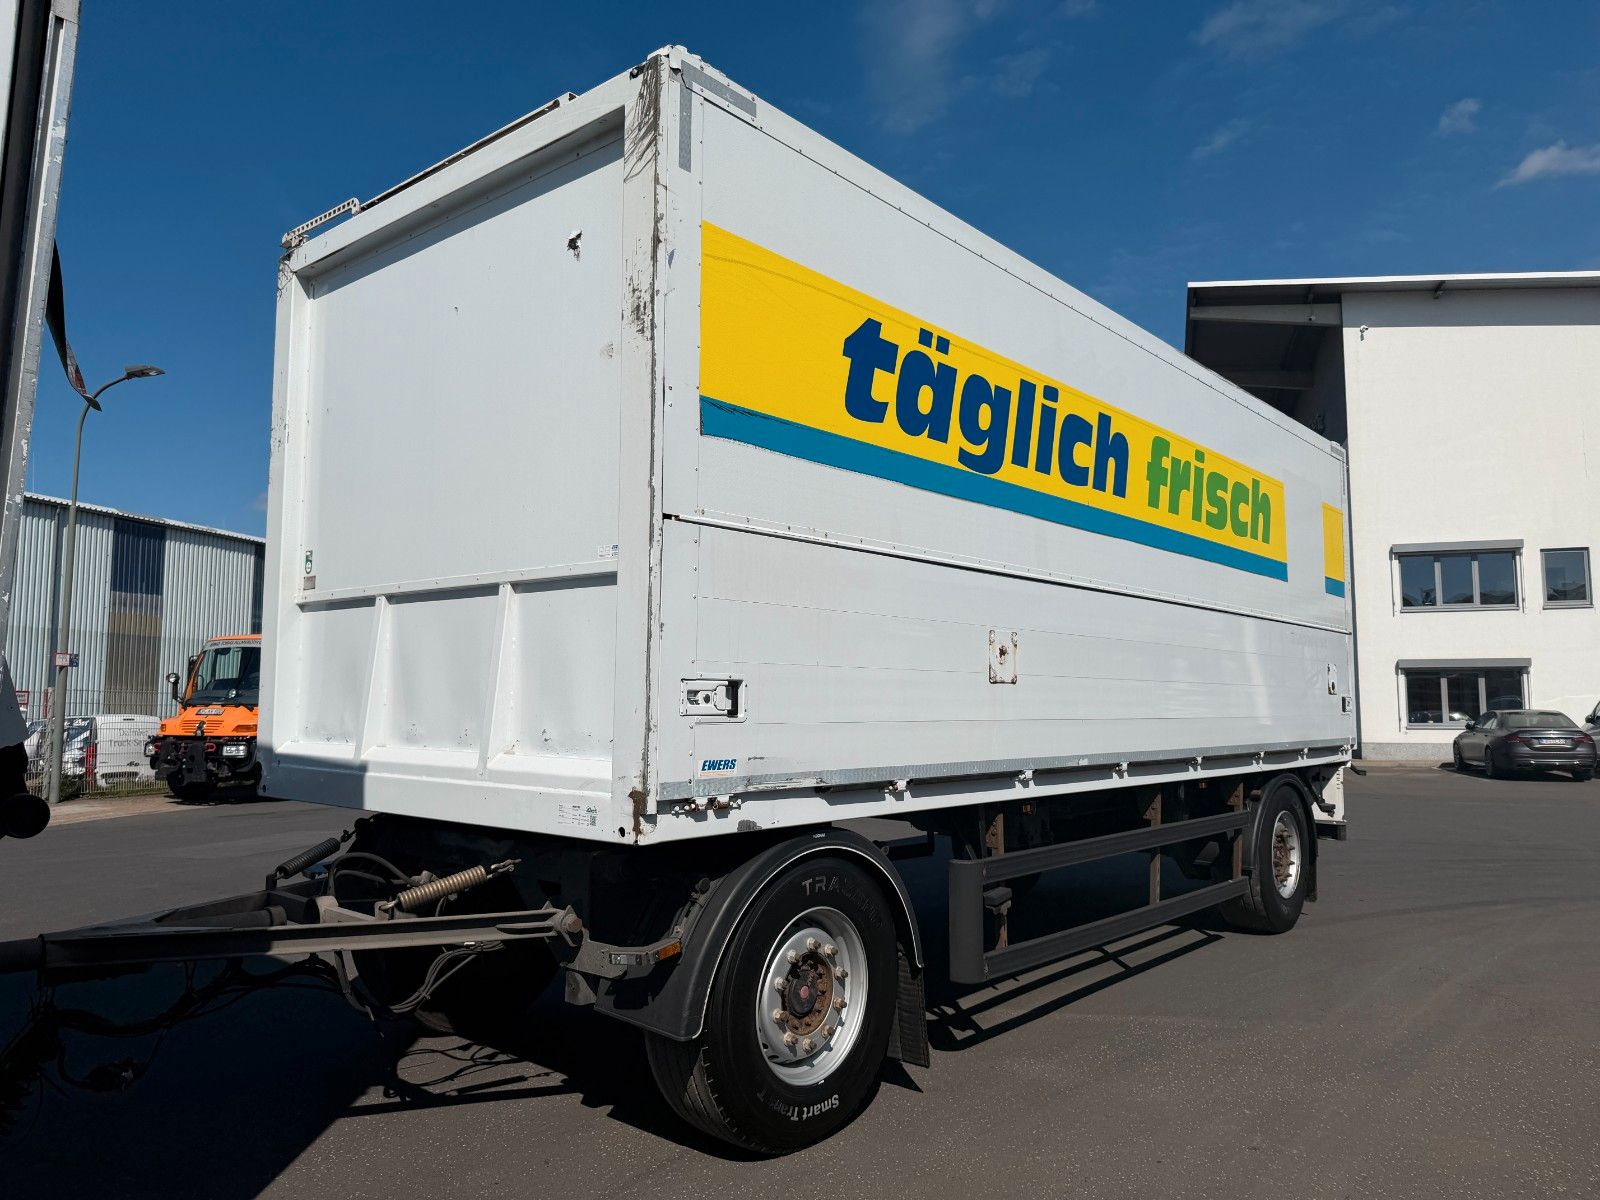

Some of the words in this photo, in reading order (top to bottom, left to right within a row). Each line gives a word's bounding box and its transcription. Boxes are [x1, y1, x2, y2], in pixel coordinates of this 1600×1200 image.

[842, 317, 1129, 498] täglich
[1147, 435, 1271, 544] frisch
[701, 758, 737, 771] EWERS
[803, 1094, 839, 1121] Smart
